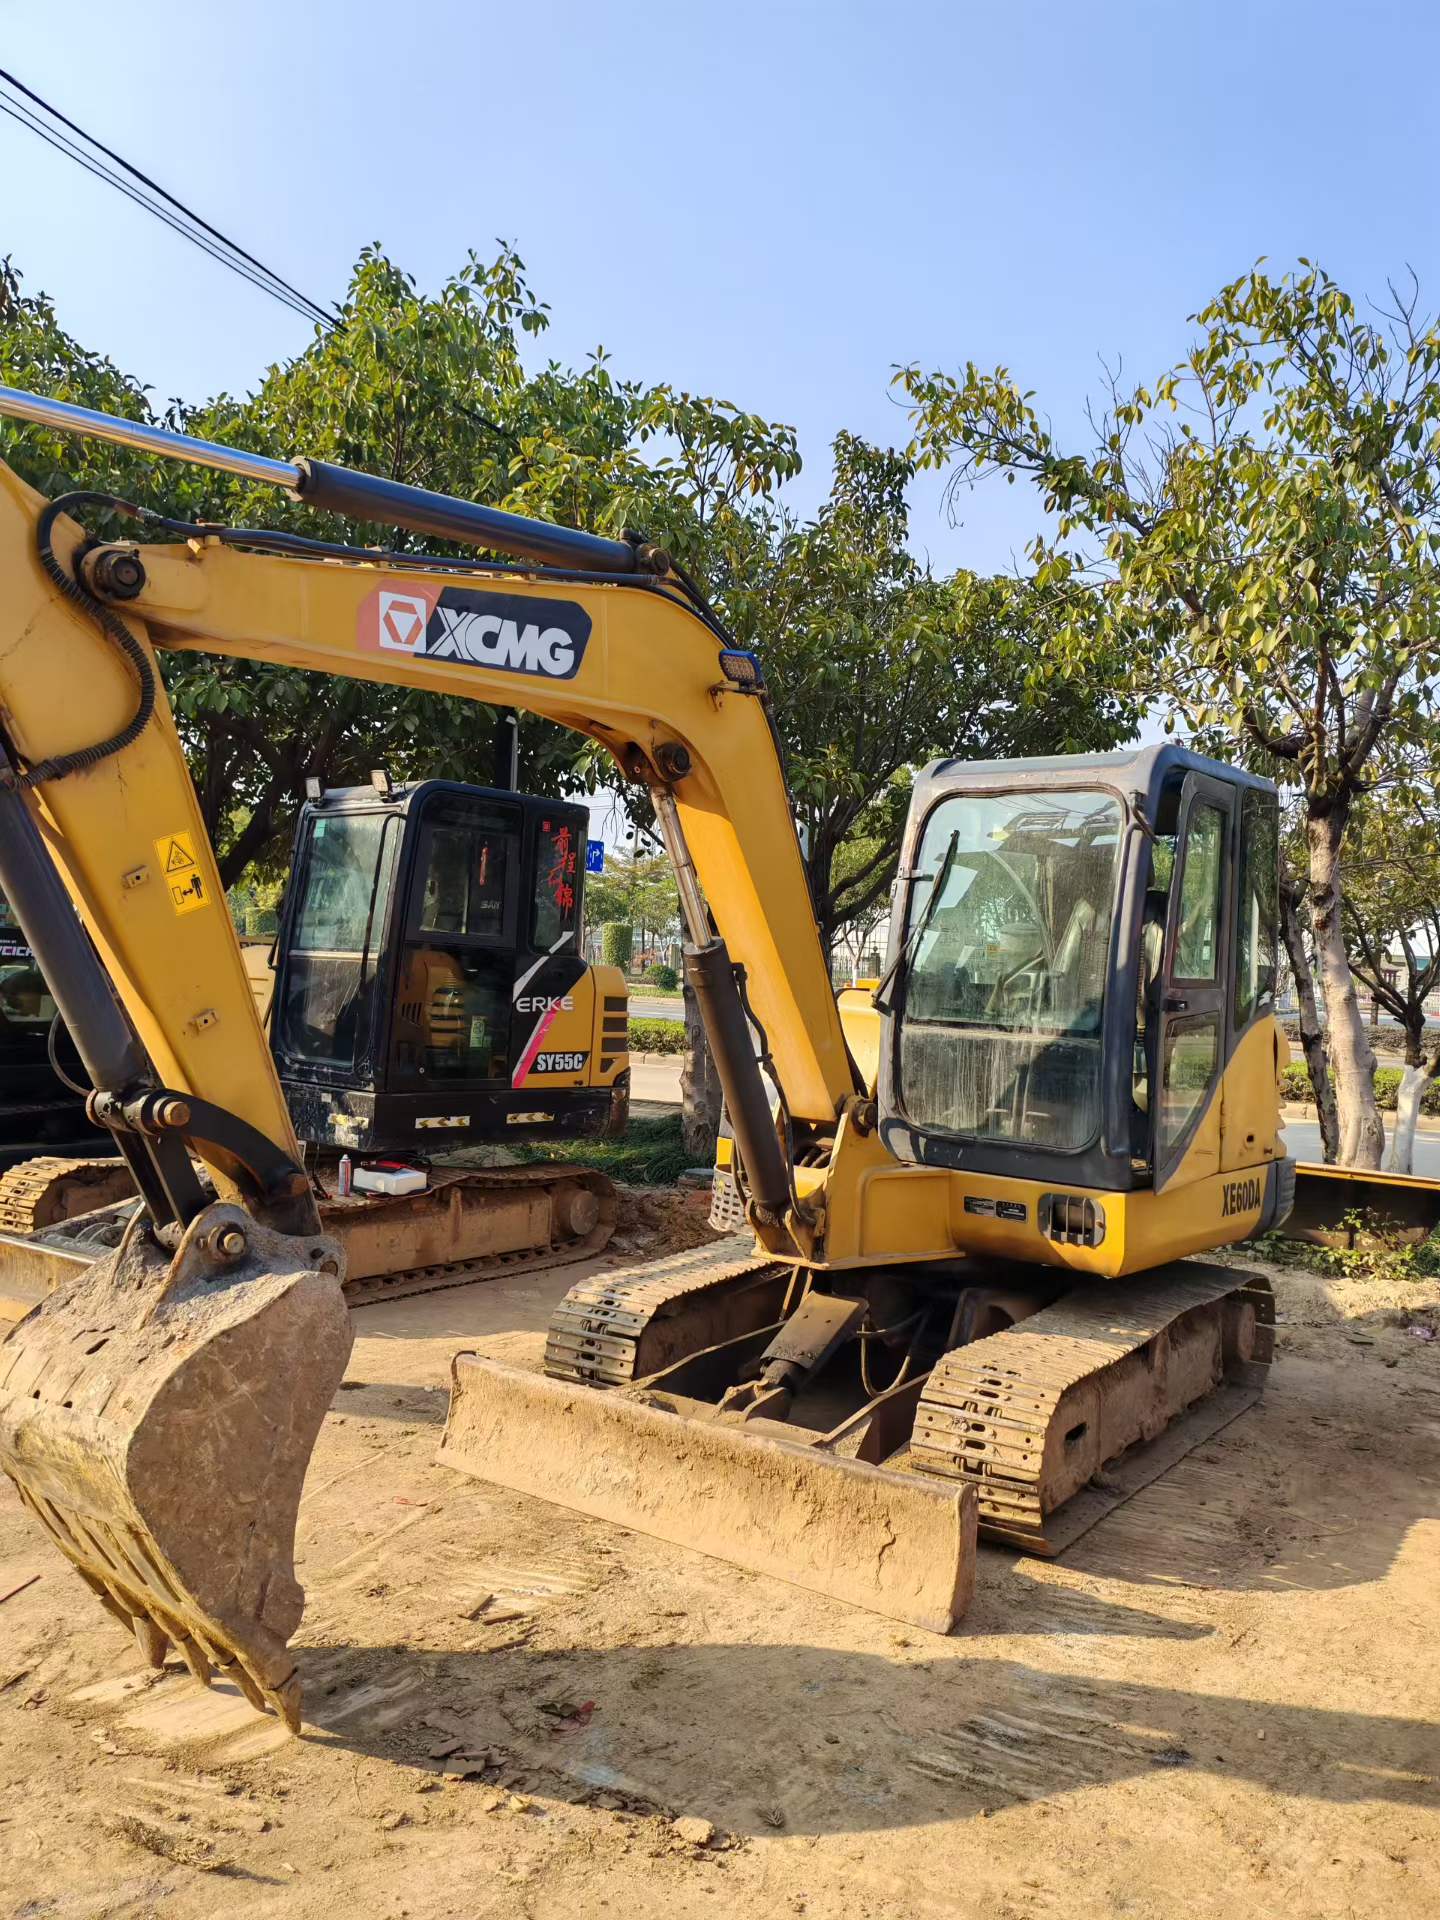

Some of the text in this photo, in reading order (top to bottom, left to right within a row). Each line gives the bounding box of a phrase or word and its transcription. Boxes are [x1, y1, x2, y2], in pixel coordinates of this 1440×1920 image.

[427, 606, 575, 676] XCMG
[516, 996, 574, 1012] ERKE
[537, 1053, 583, 1071] SY55C
[1222, 1177, 1261, 1217] XE60DA
